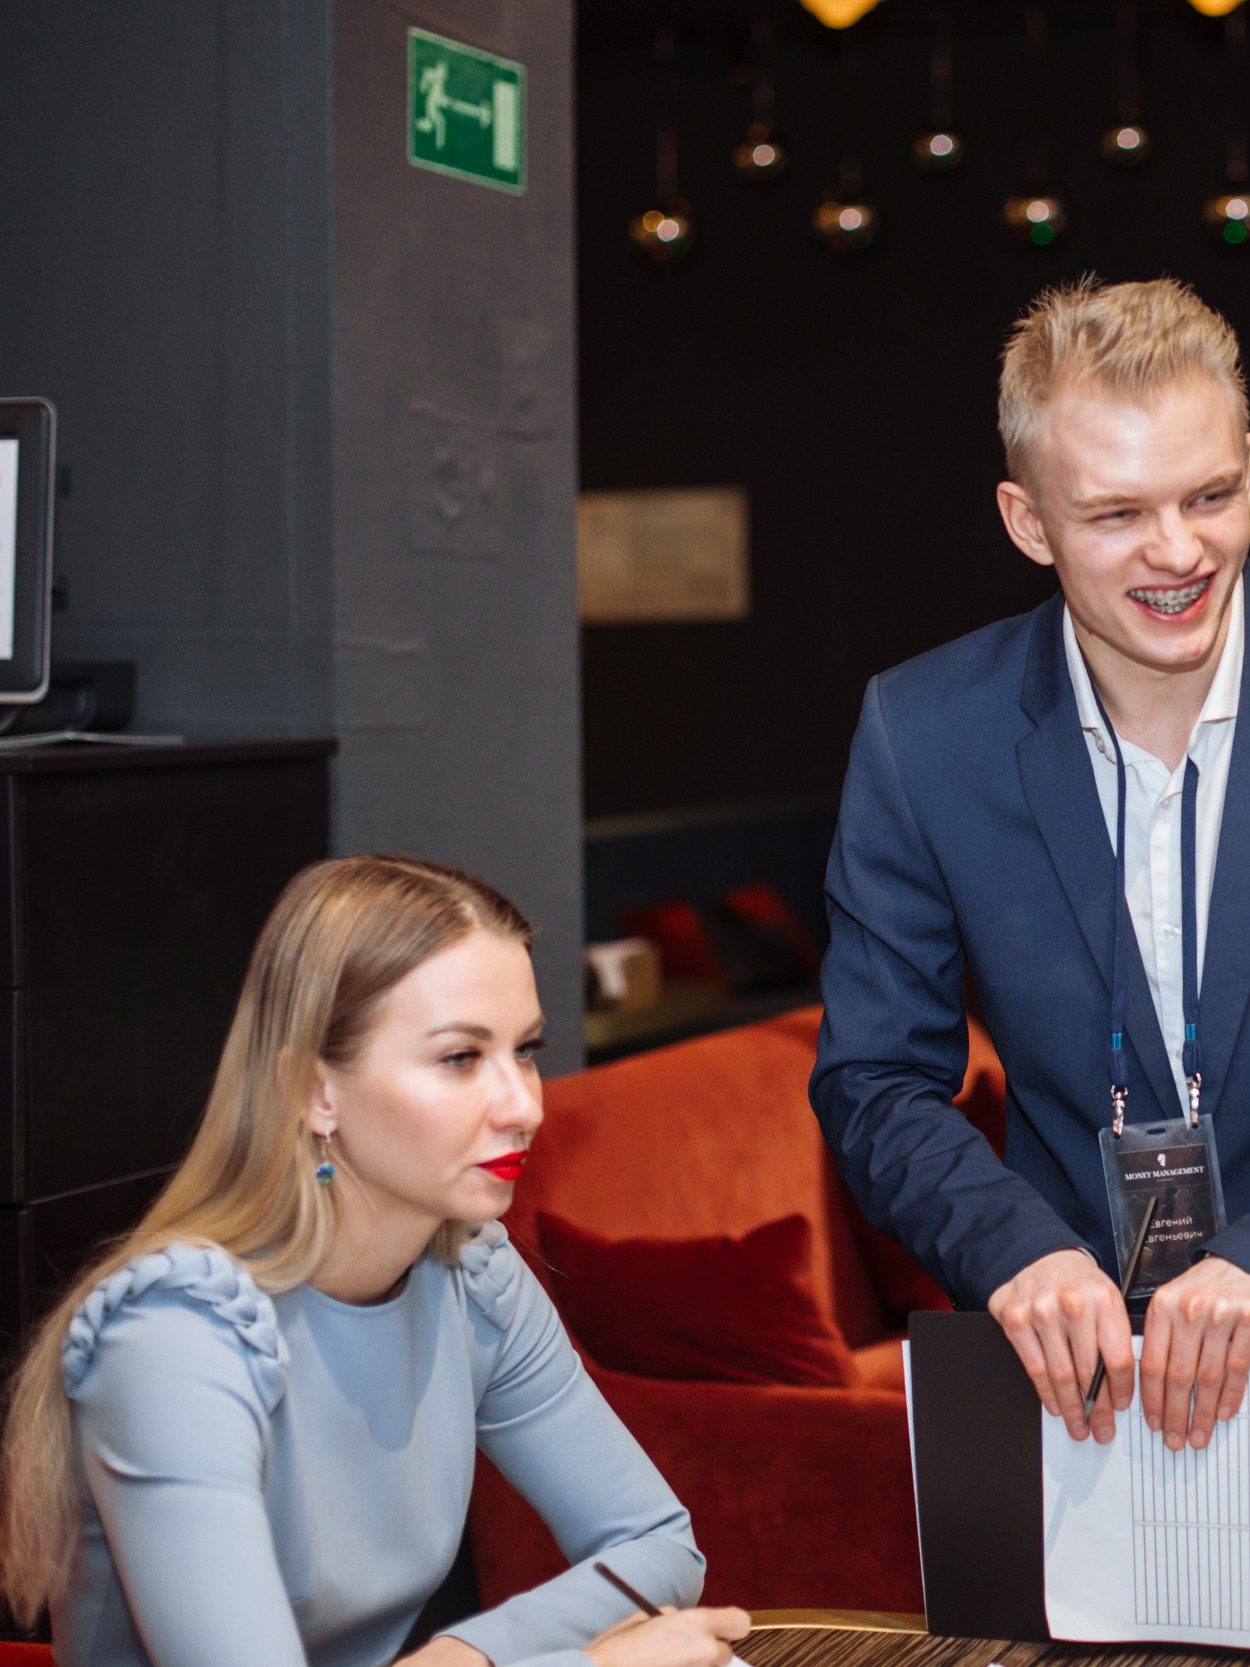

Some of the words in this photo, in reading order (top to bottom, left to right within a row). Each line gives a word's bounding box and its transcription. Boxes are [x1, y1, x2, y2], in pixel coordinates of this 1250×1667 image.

[1124, 1171, 1152, 1181] MONEY
[1153, 1166, 1204, 1178] MANAGEMENT
[1145, 1232, 1203, 1243] вгеньевич
